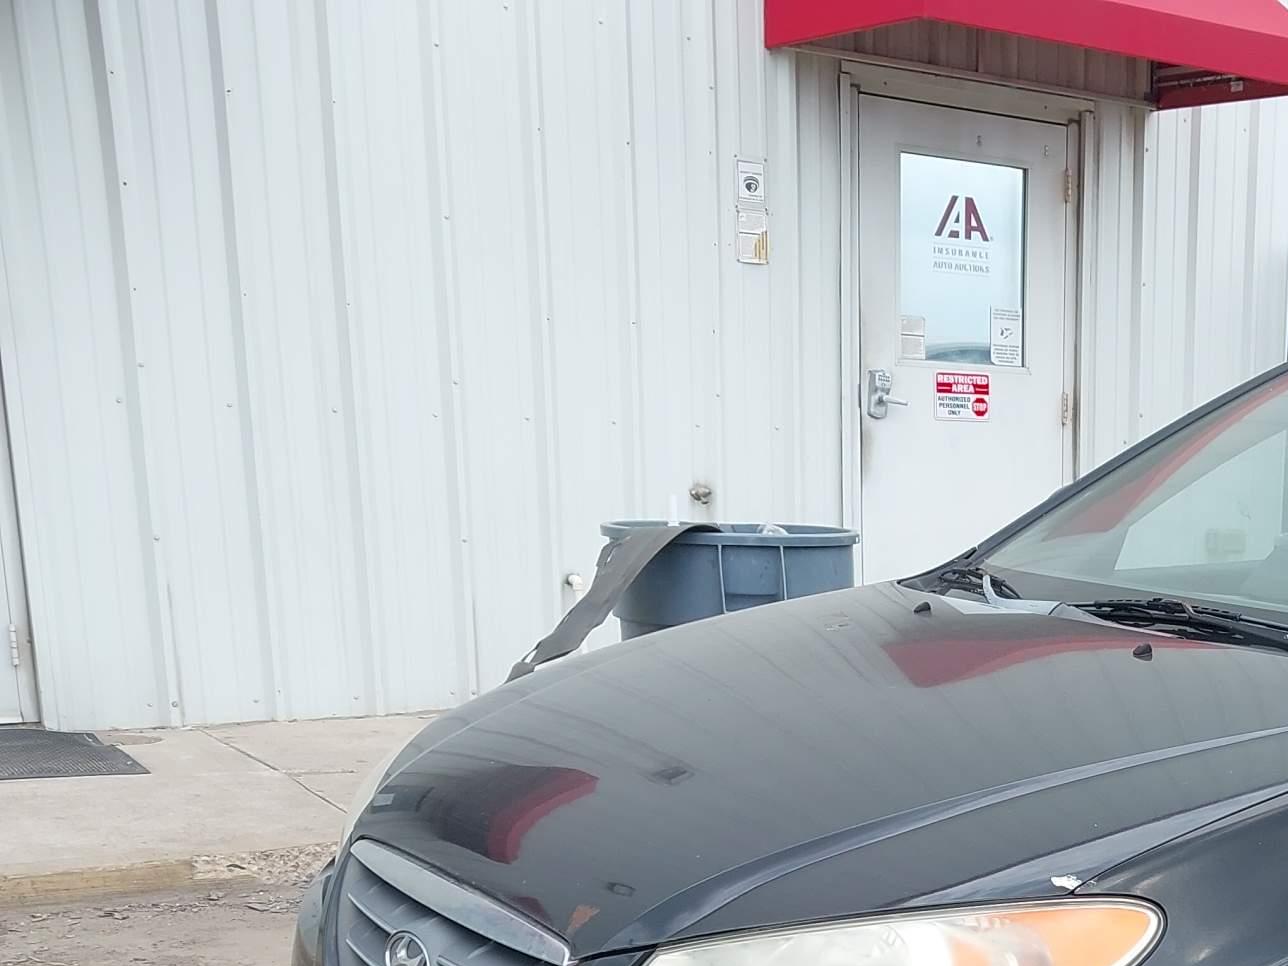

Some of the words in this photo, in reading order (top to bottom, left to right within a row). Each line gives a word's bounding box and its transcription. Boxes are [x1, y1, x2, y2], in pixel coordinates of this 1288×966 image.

[932, 261, 953, 270] AUTO
[954, 263, 990, 274] AUCTIONS
[937, 374, 988, 386] RESTRICTED
[951, 384, 975, 393] AREA
[938, 395, 971, 403] AUTHORIZED
[938, 402, 970, 410] PERSONNEL
[973, 402, 987, 412] STOP
